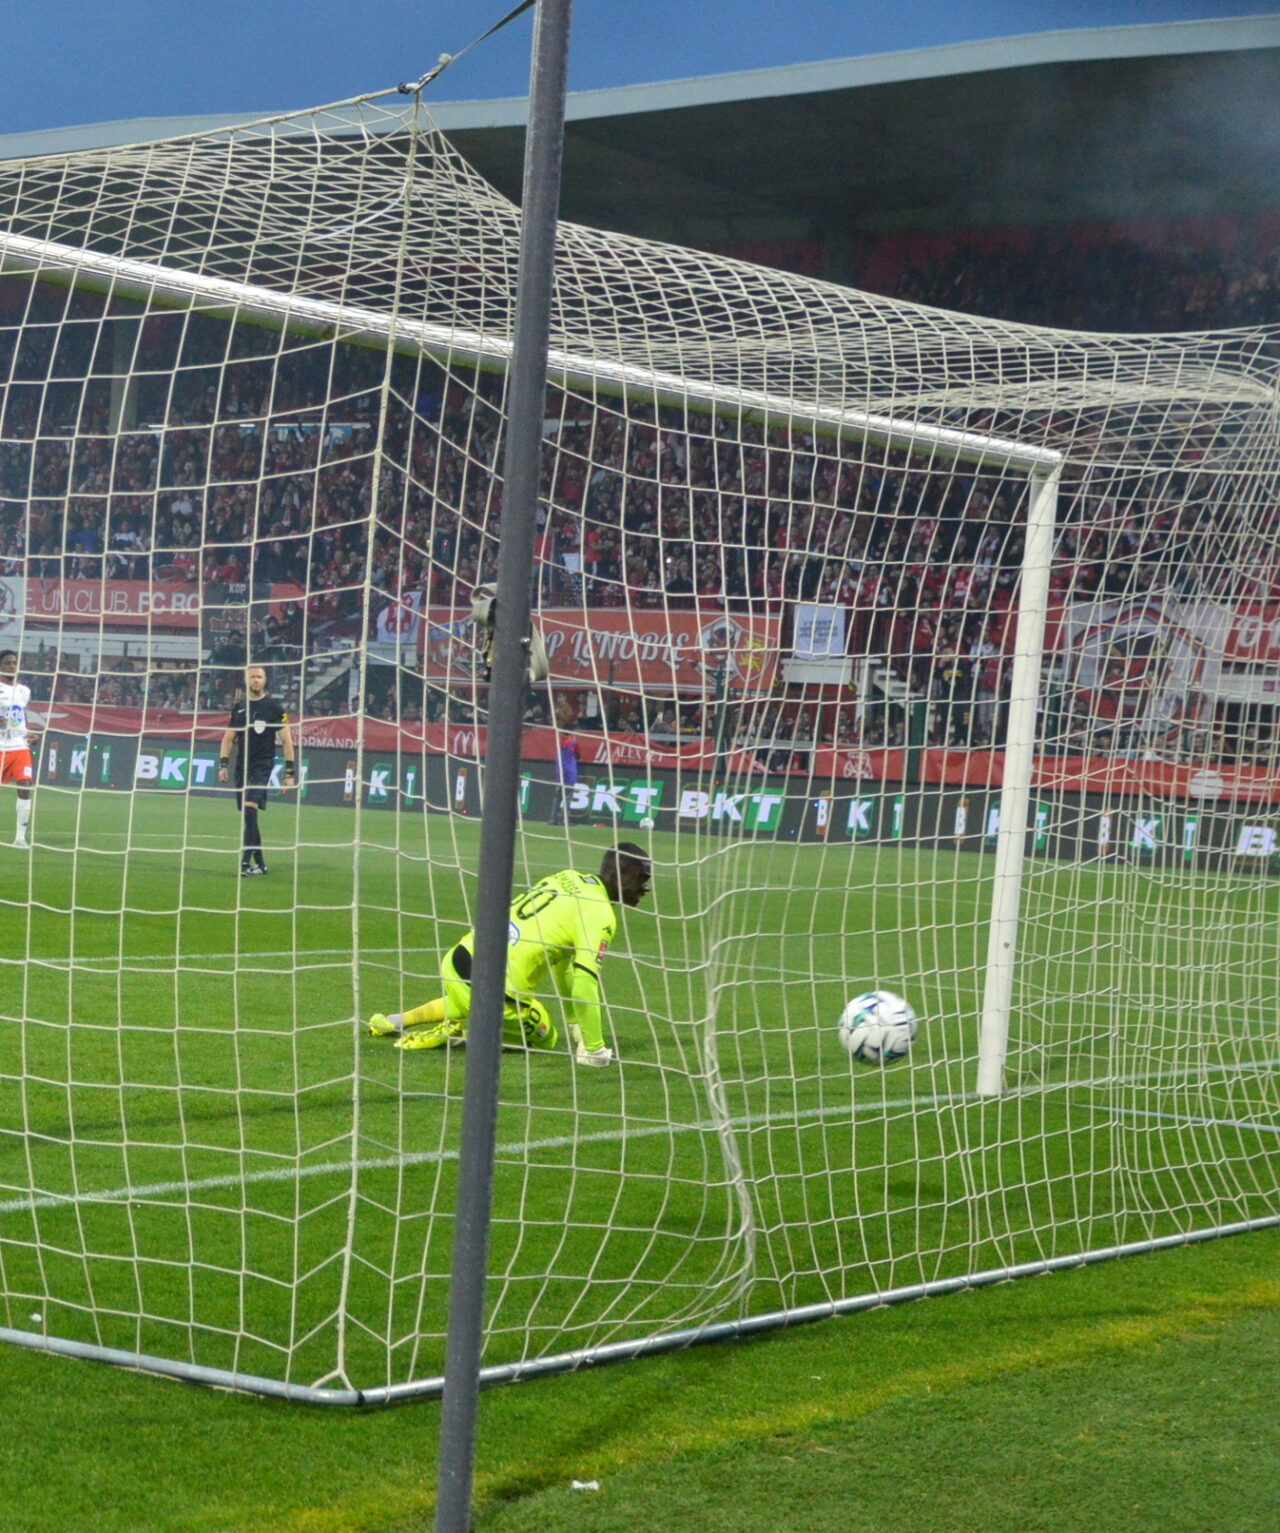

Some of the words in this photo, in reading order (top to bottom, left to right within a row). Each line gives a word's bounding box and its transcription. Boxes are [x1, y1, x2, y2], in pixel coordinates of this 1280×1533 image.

[42, 590, 70, 612] UN
[138, 592, 165, 614] FC
[136, 754, 214, 783] BKT
[678, 790, 782, 822] BKT
[524, 1007, 541, 1036] 30
